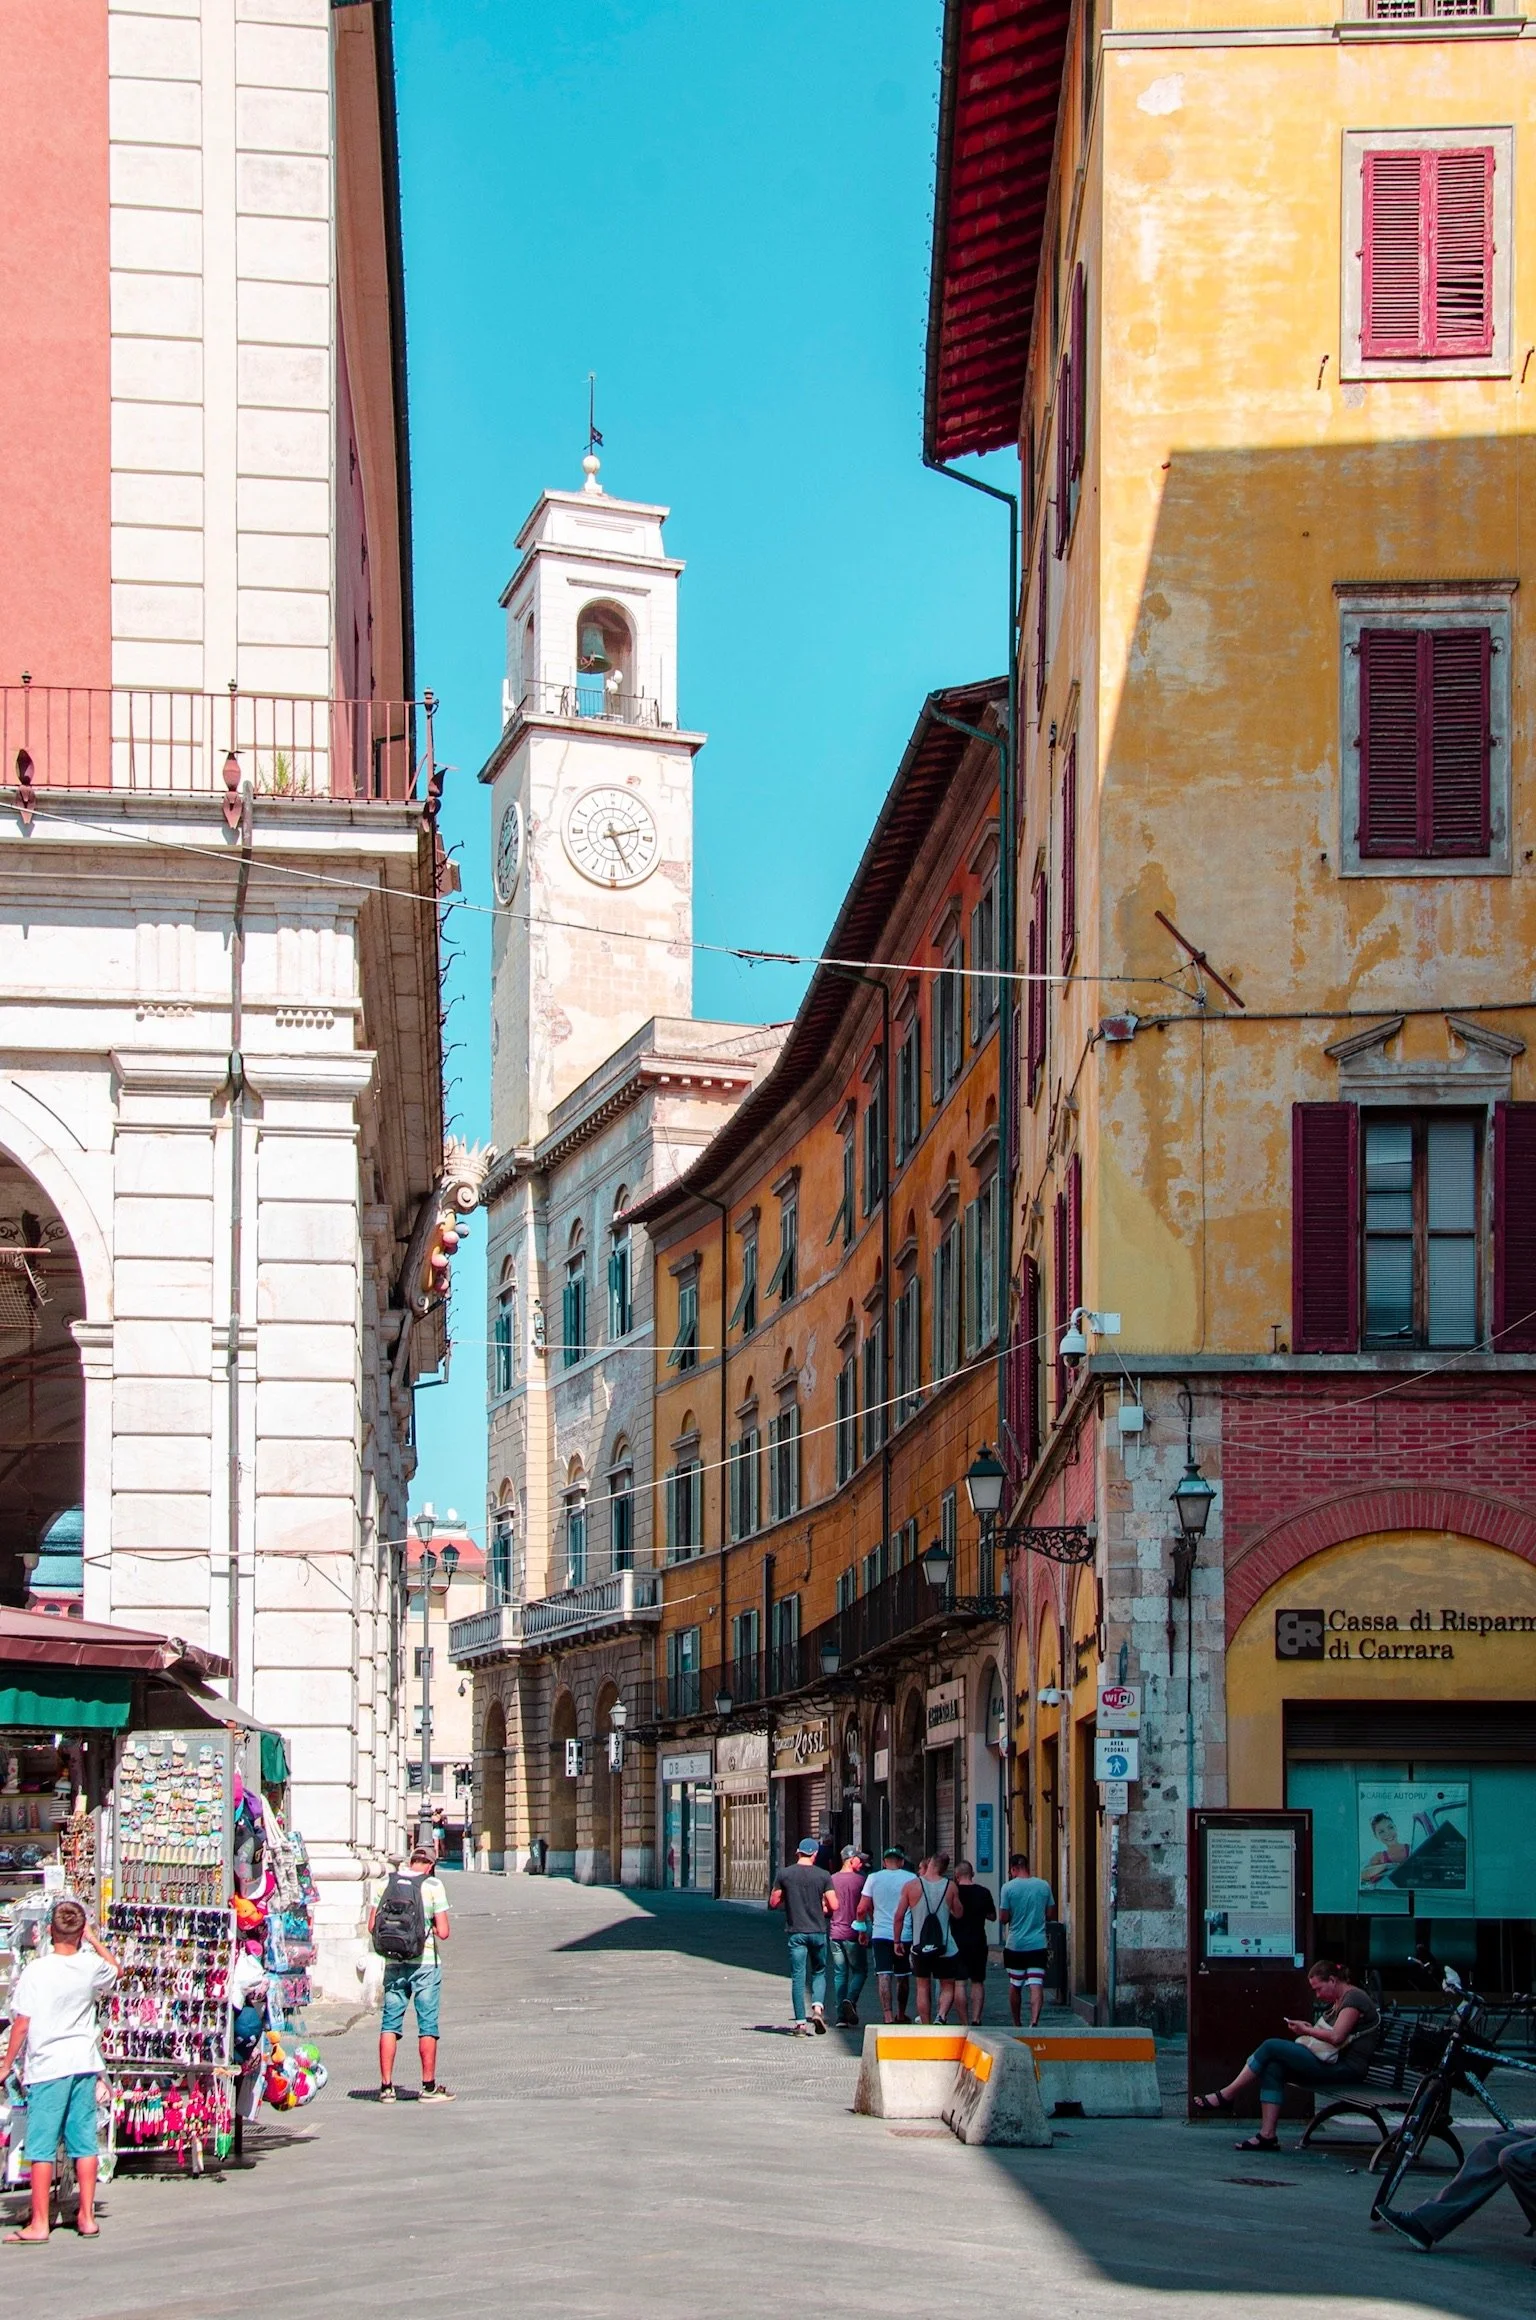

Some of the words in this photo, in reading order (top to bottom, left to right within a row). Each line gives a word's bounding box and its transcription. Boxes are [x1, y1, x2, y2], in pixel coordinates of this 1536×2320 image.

[1328, 1609, 1399, 1631] Cassa
[1410, 1609, 1431, 1631] di
[1328, 1638, 1350, 1660] di
[1358, 1638, 1455, 1660] Carrara
[1366, 1792, 1392, 1800] CARIGE
